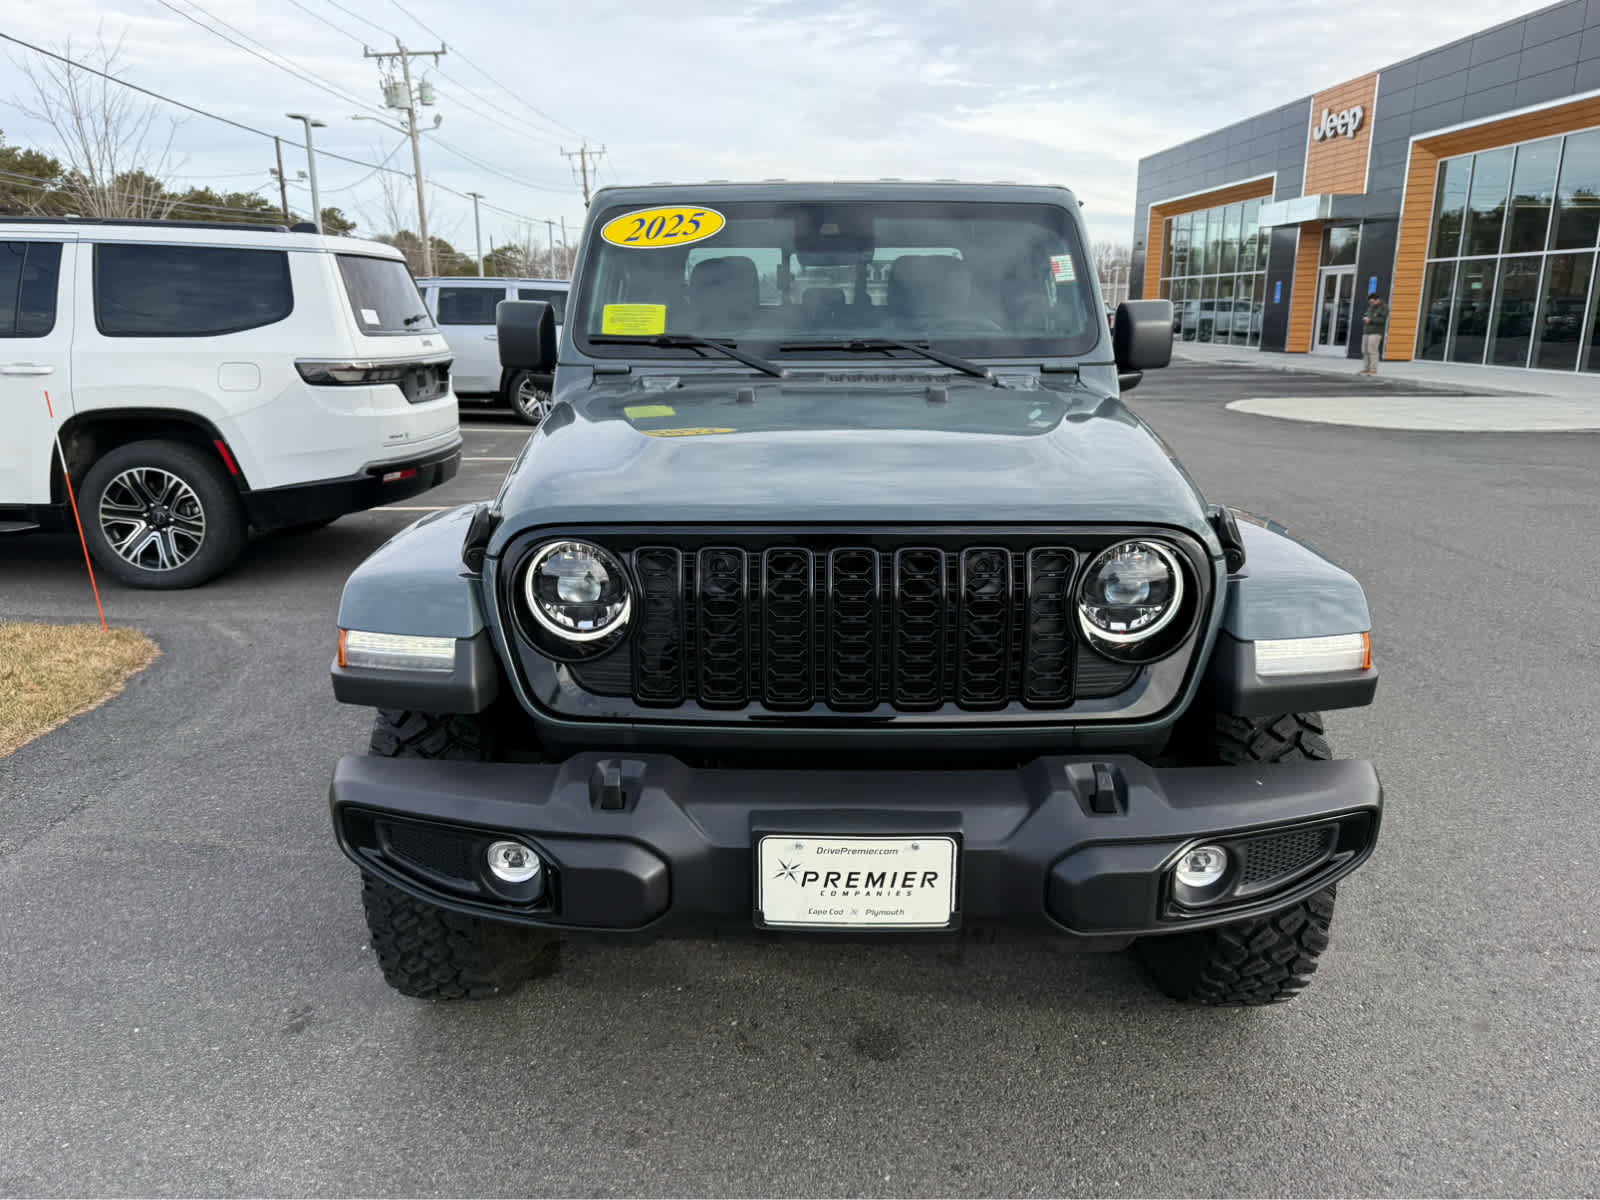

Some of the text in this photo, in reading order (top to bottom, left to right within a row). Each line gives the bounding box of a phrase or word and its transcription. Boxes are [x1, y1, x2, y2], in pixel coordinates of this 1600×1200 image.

[1313, 105, 1363, 141] Jeep
[623, 212, 706, 242] 2025
[816, 846, 899, 856] DrivePremier.com
[801, 871, 939, 888] PREMIER
[808, 908, 905, 917] Cape Cod Plymouth
